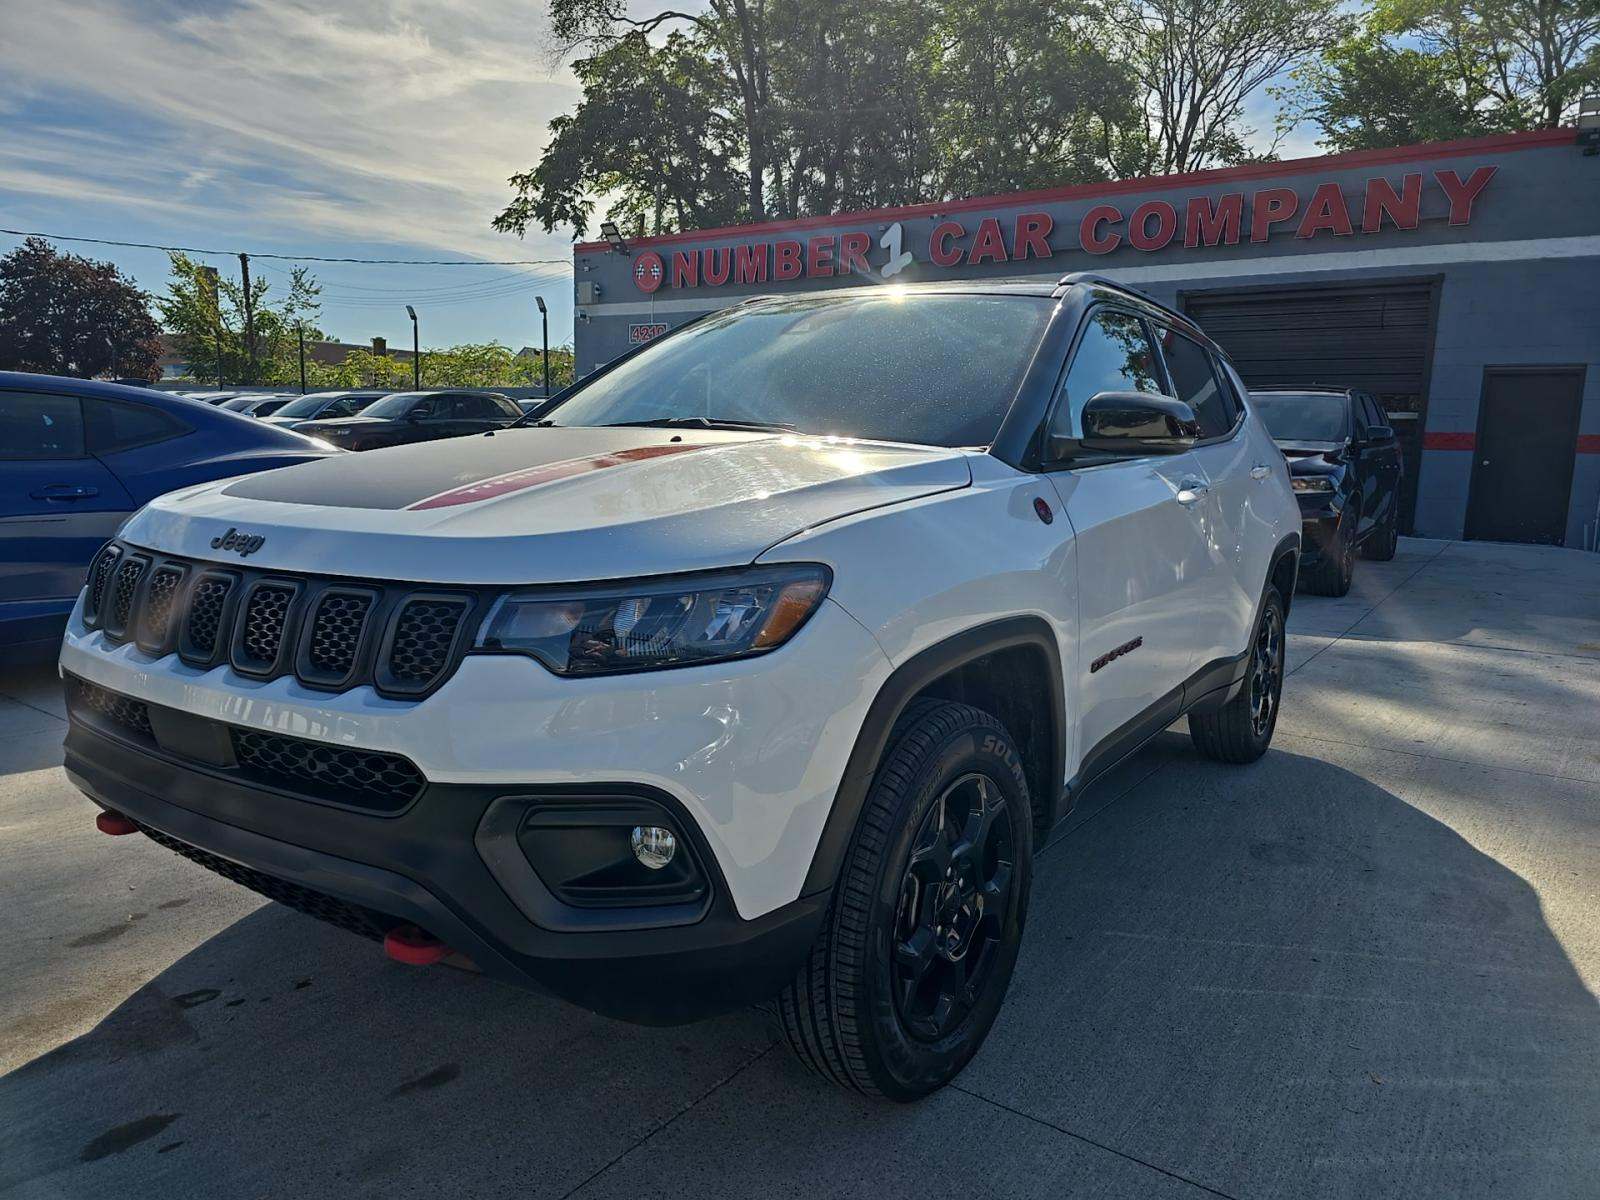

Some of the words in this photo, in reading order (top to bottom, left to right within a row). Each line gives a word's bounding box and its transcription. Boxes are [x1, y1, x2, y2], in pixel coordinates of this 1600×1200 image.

[672, 231, 871, 288] NUMBER
[879, 222, 912, 277] 1
[929, 213, 1053, 266] CAR
[1079, 166, 1498, 254] COMPANY
[210, 527, 266, 557] Jeep
